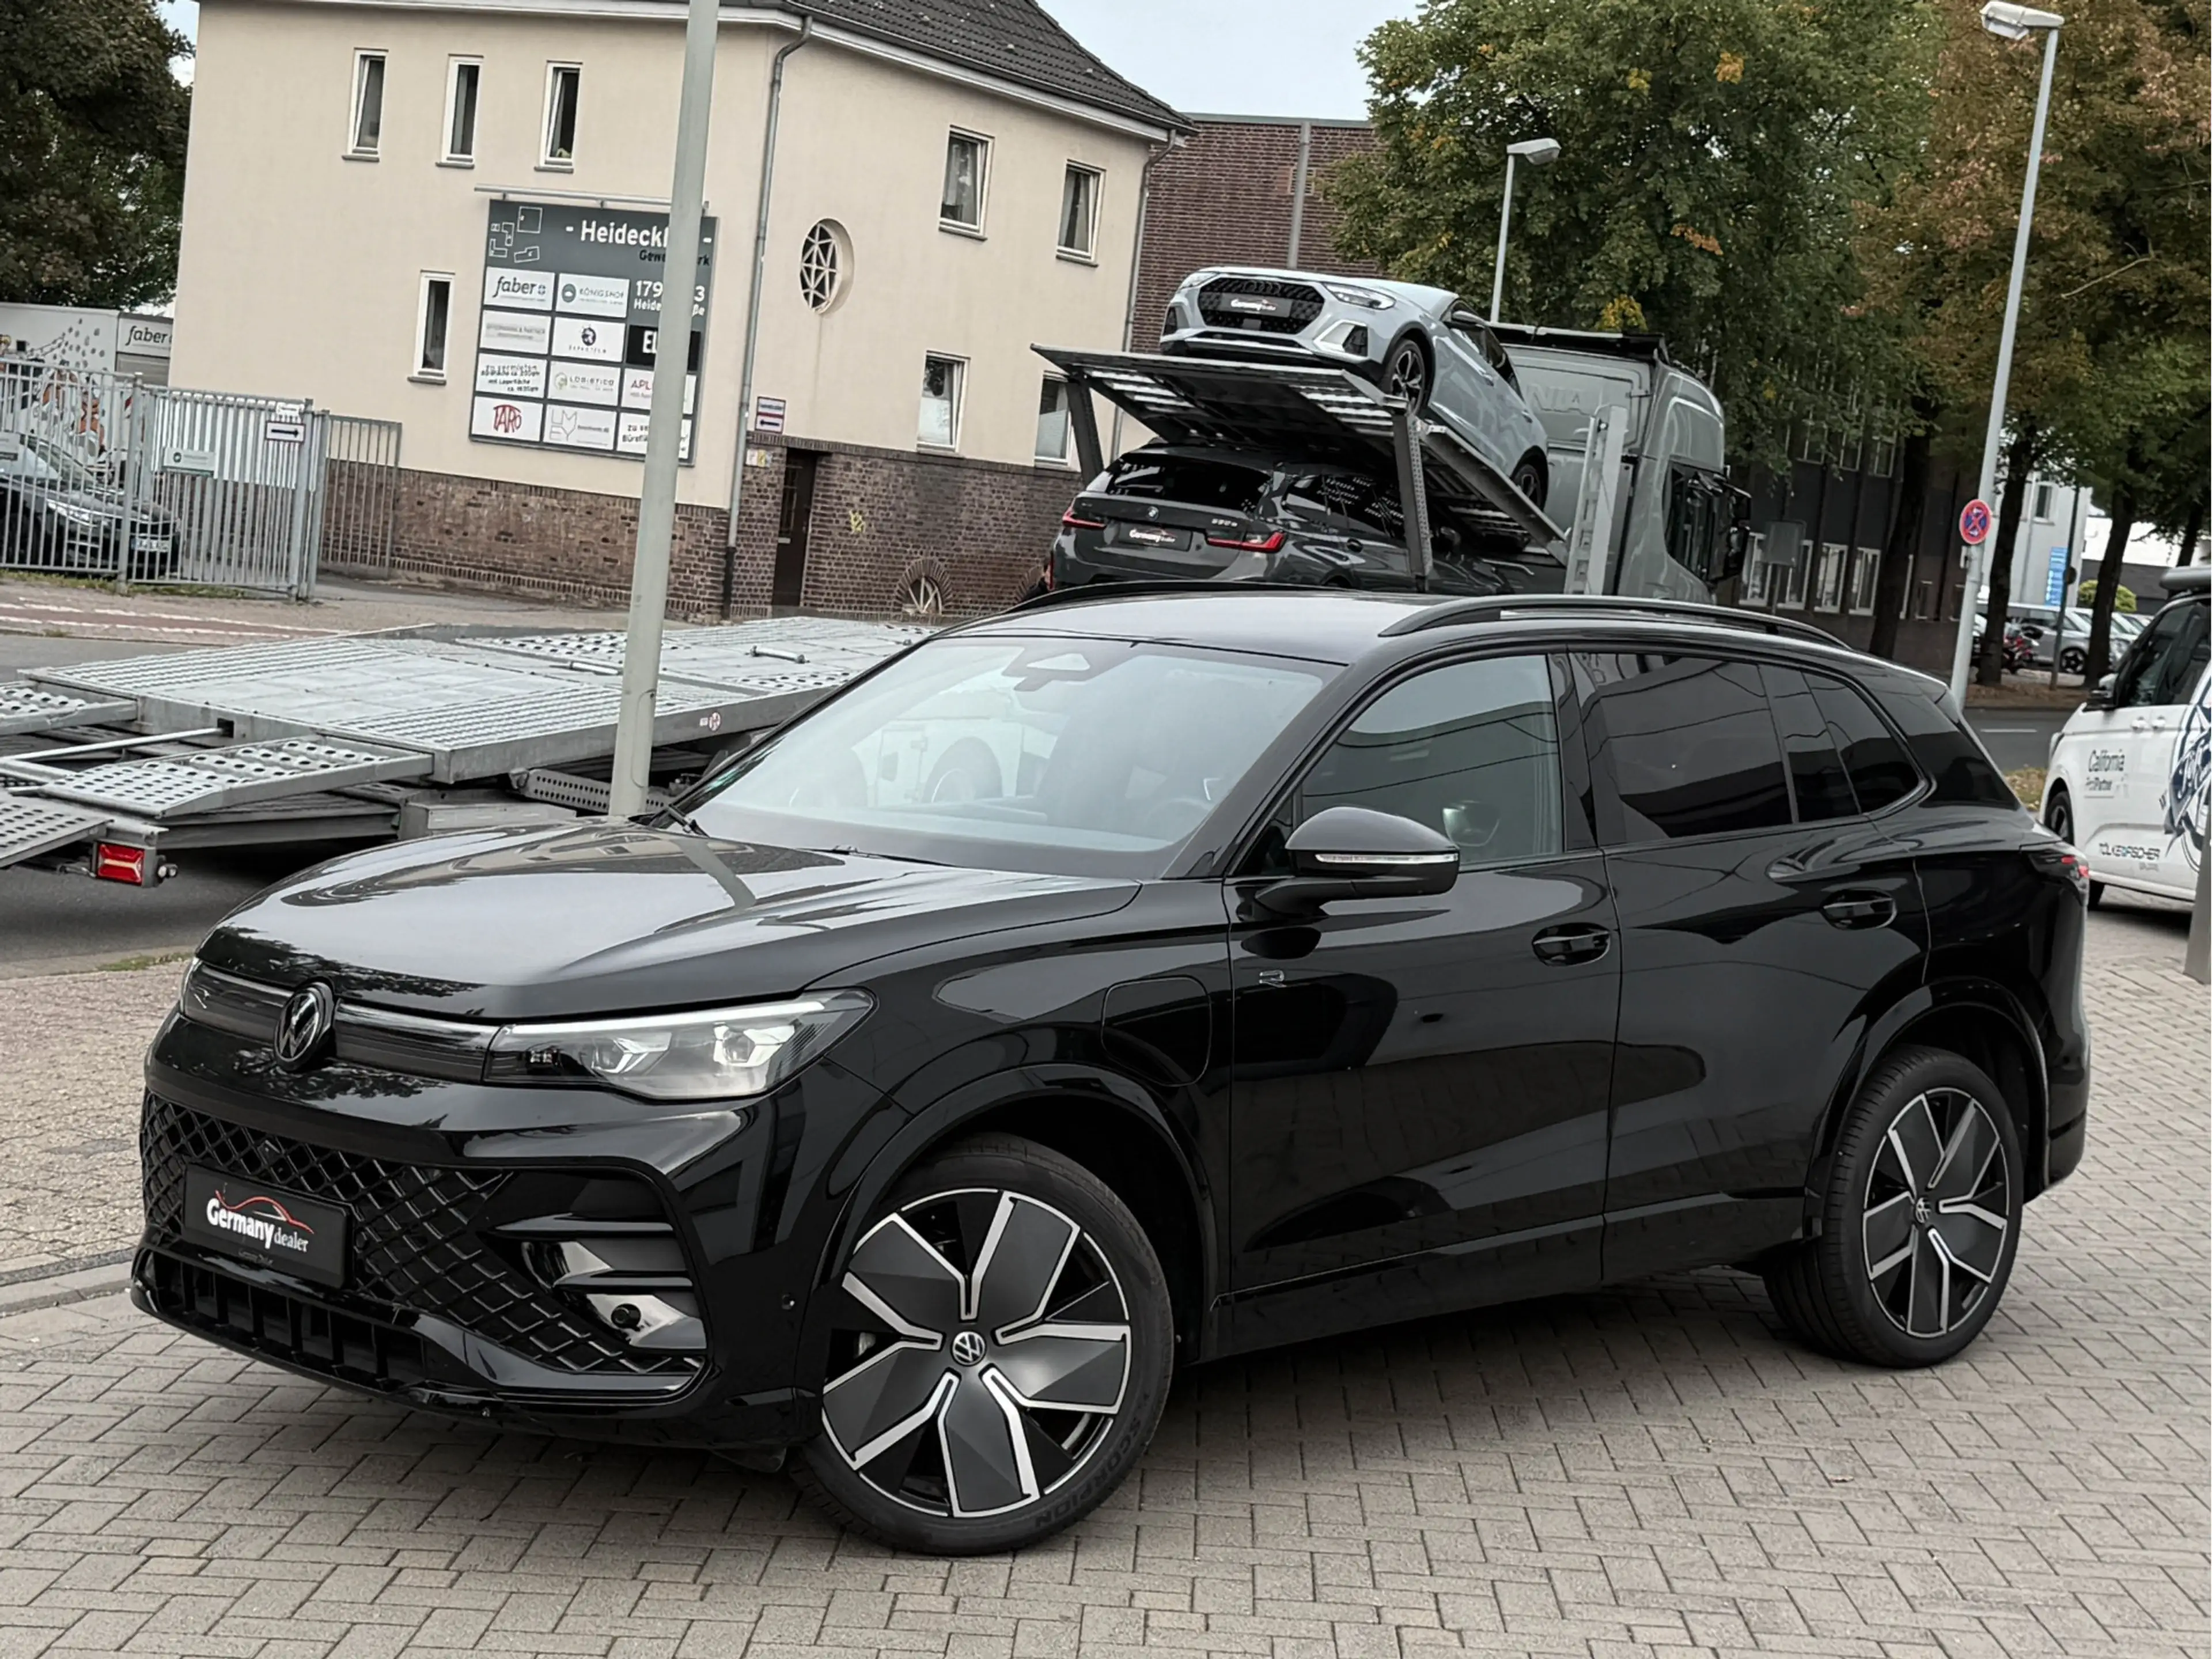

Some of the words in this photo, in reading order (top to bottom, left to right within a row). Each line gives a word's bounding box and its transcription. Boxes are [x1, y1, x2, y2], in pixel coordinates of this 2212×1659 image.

[493, 276, 536, 298] faber
[125, 325, 168, 346] faber
[206, 1197, 275, 1250] Germany
[274, 1229, 309, 1253] dealer
